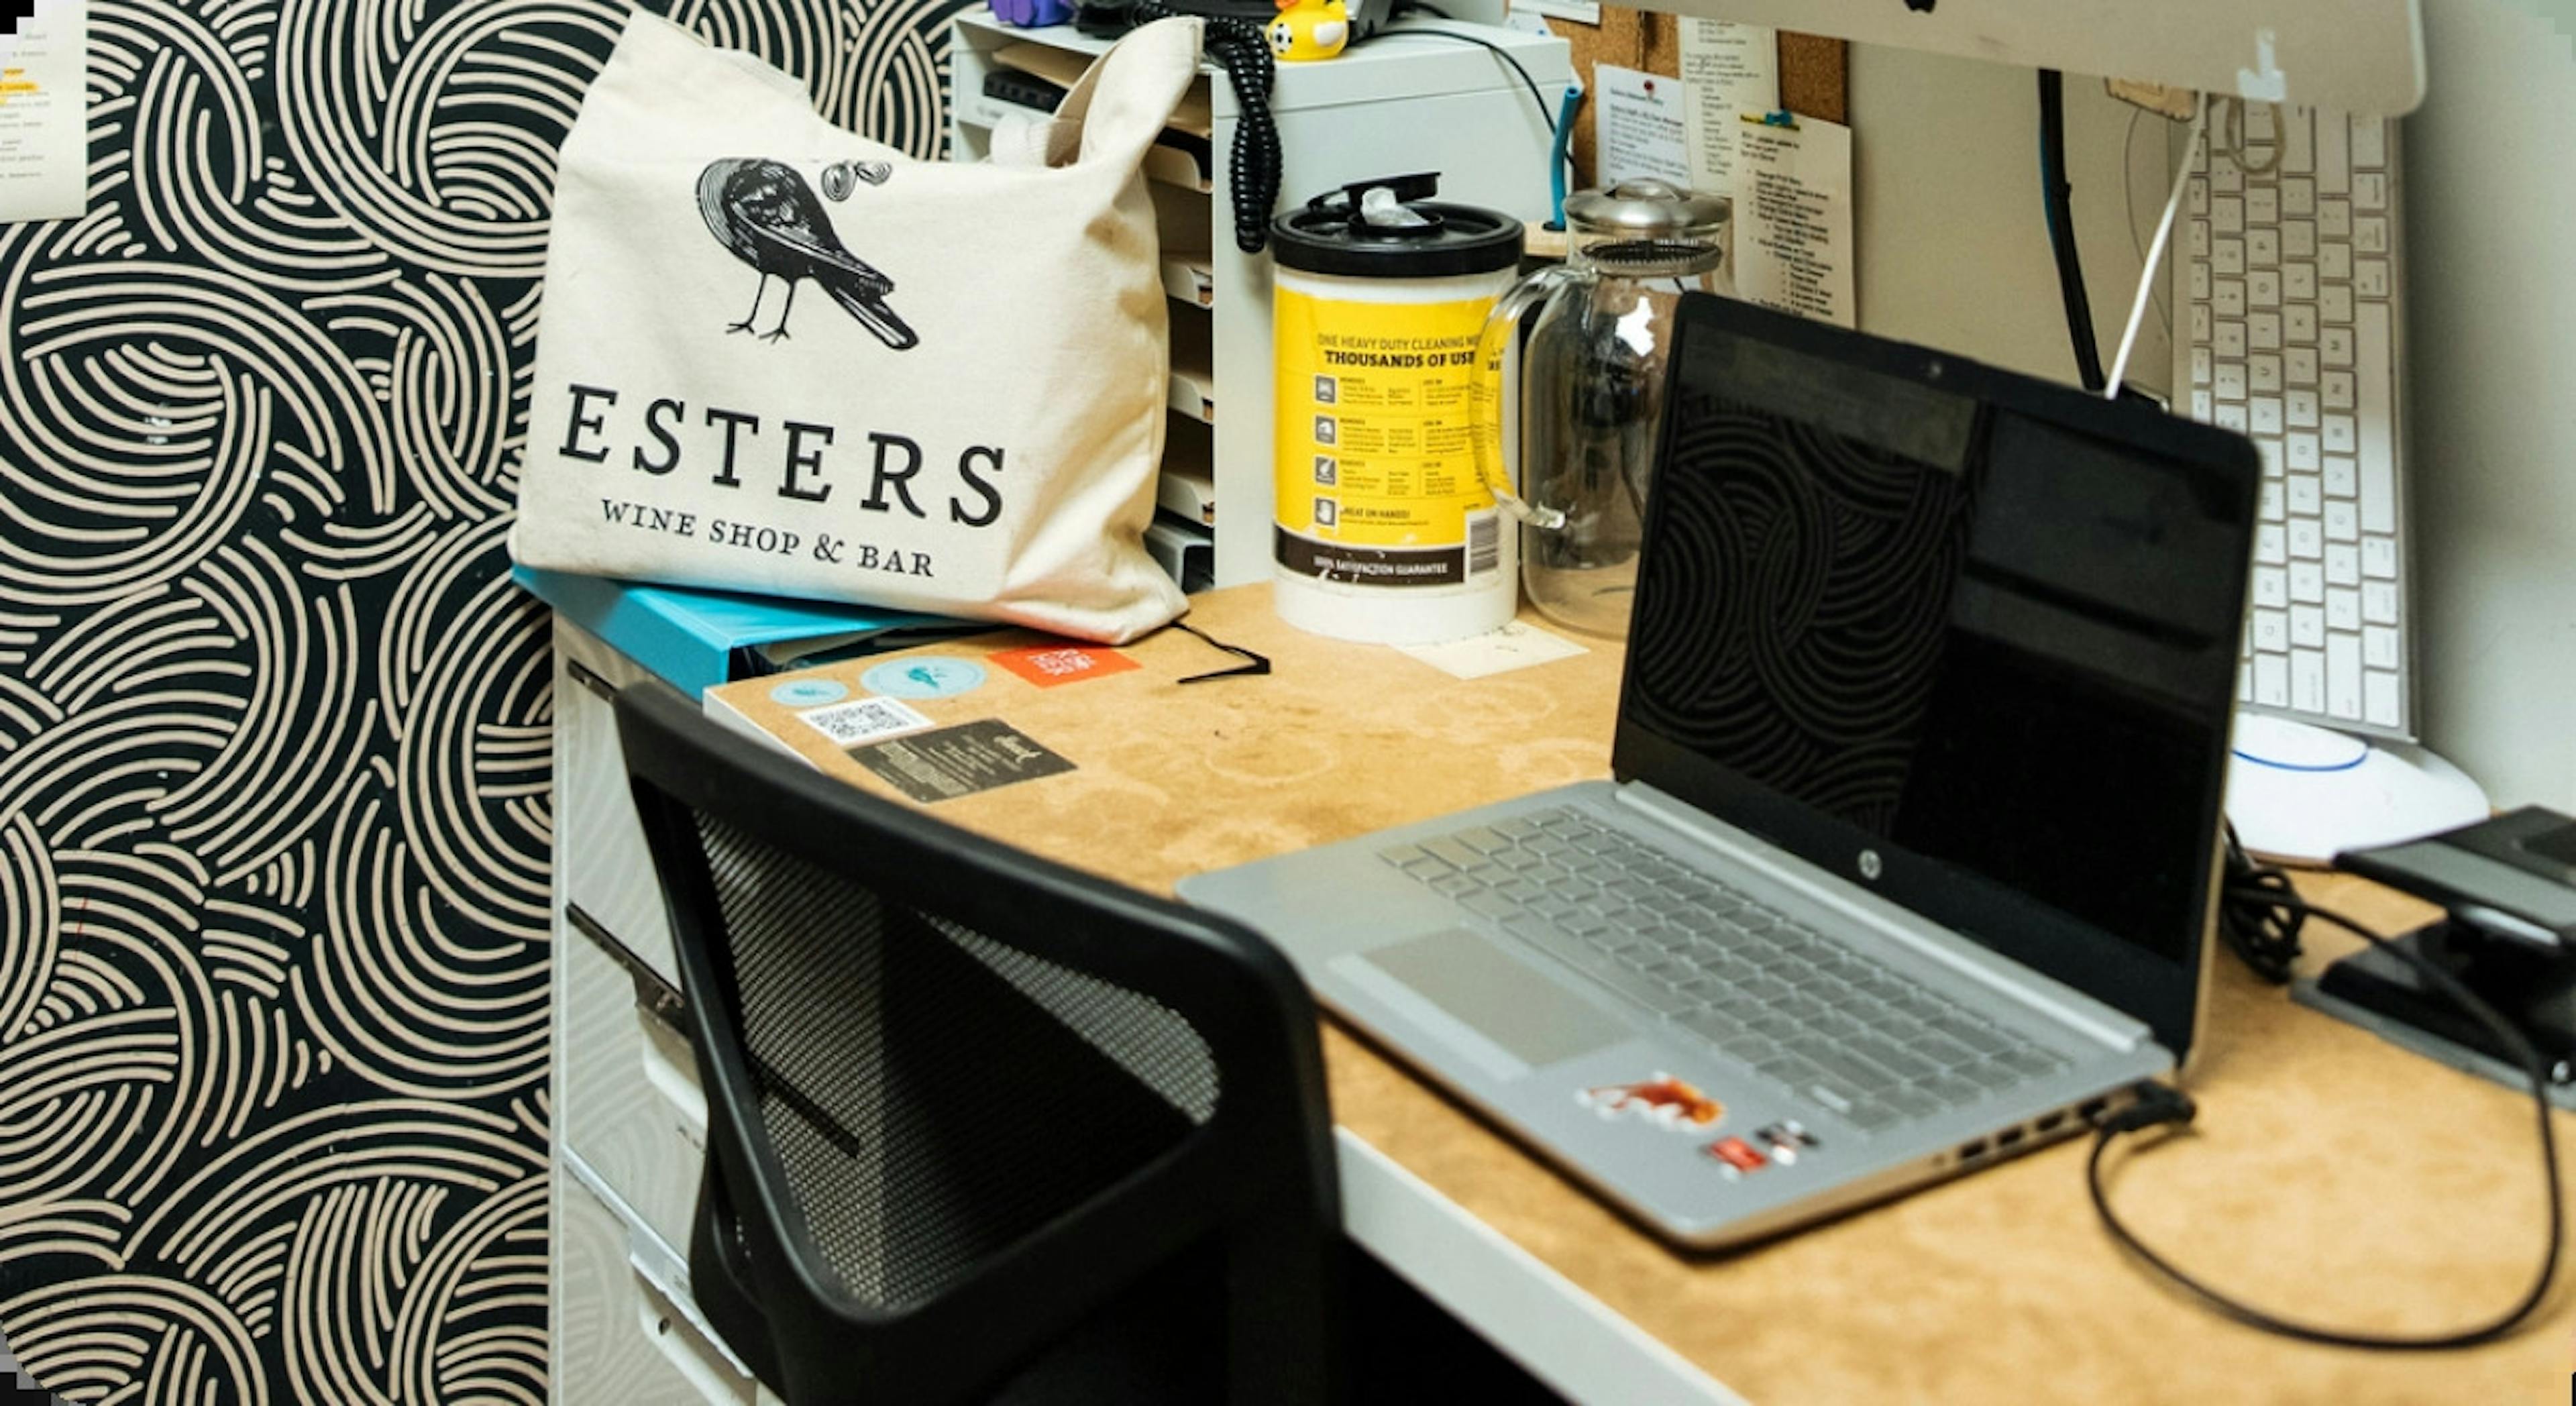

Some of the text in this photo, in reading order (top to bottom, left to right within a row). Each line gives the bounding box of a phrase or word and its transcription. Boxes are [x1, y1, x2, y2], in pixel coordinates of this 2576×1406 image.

[1342, 335, 1376, 349] HEAVY
[1380, 338, 1408, 350] DUTY
[1411, 337, 1464, 350] CLEANING
[1324, 349, 1422, 368] THOUSANDS
[1428, 354, 1446, 367] OF
[559, 385, 1003, 527] ESTERS
[601, 498, 934, 577] WINE SHOP & BAR
[1336, 559, 1393, 575] SATISFACTION
[1395, 563, 1448, 574] GUARANTEE
